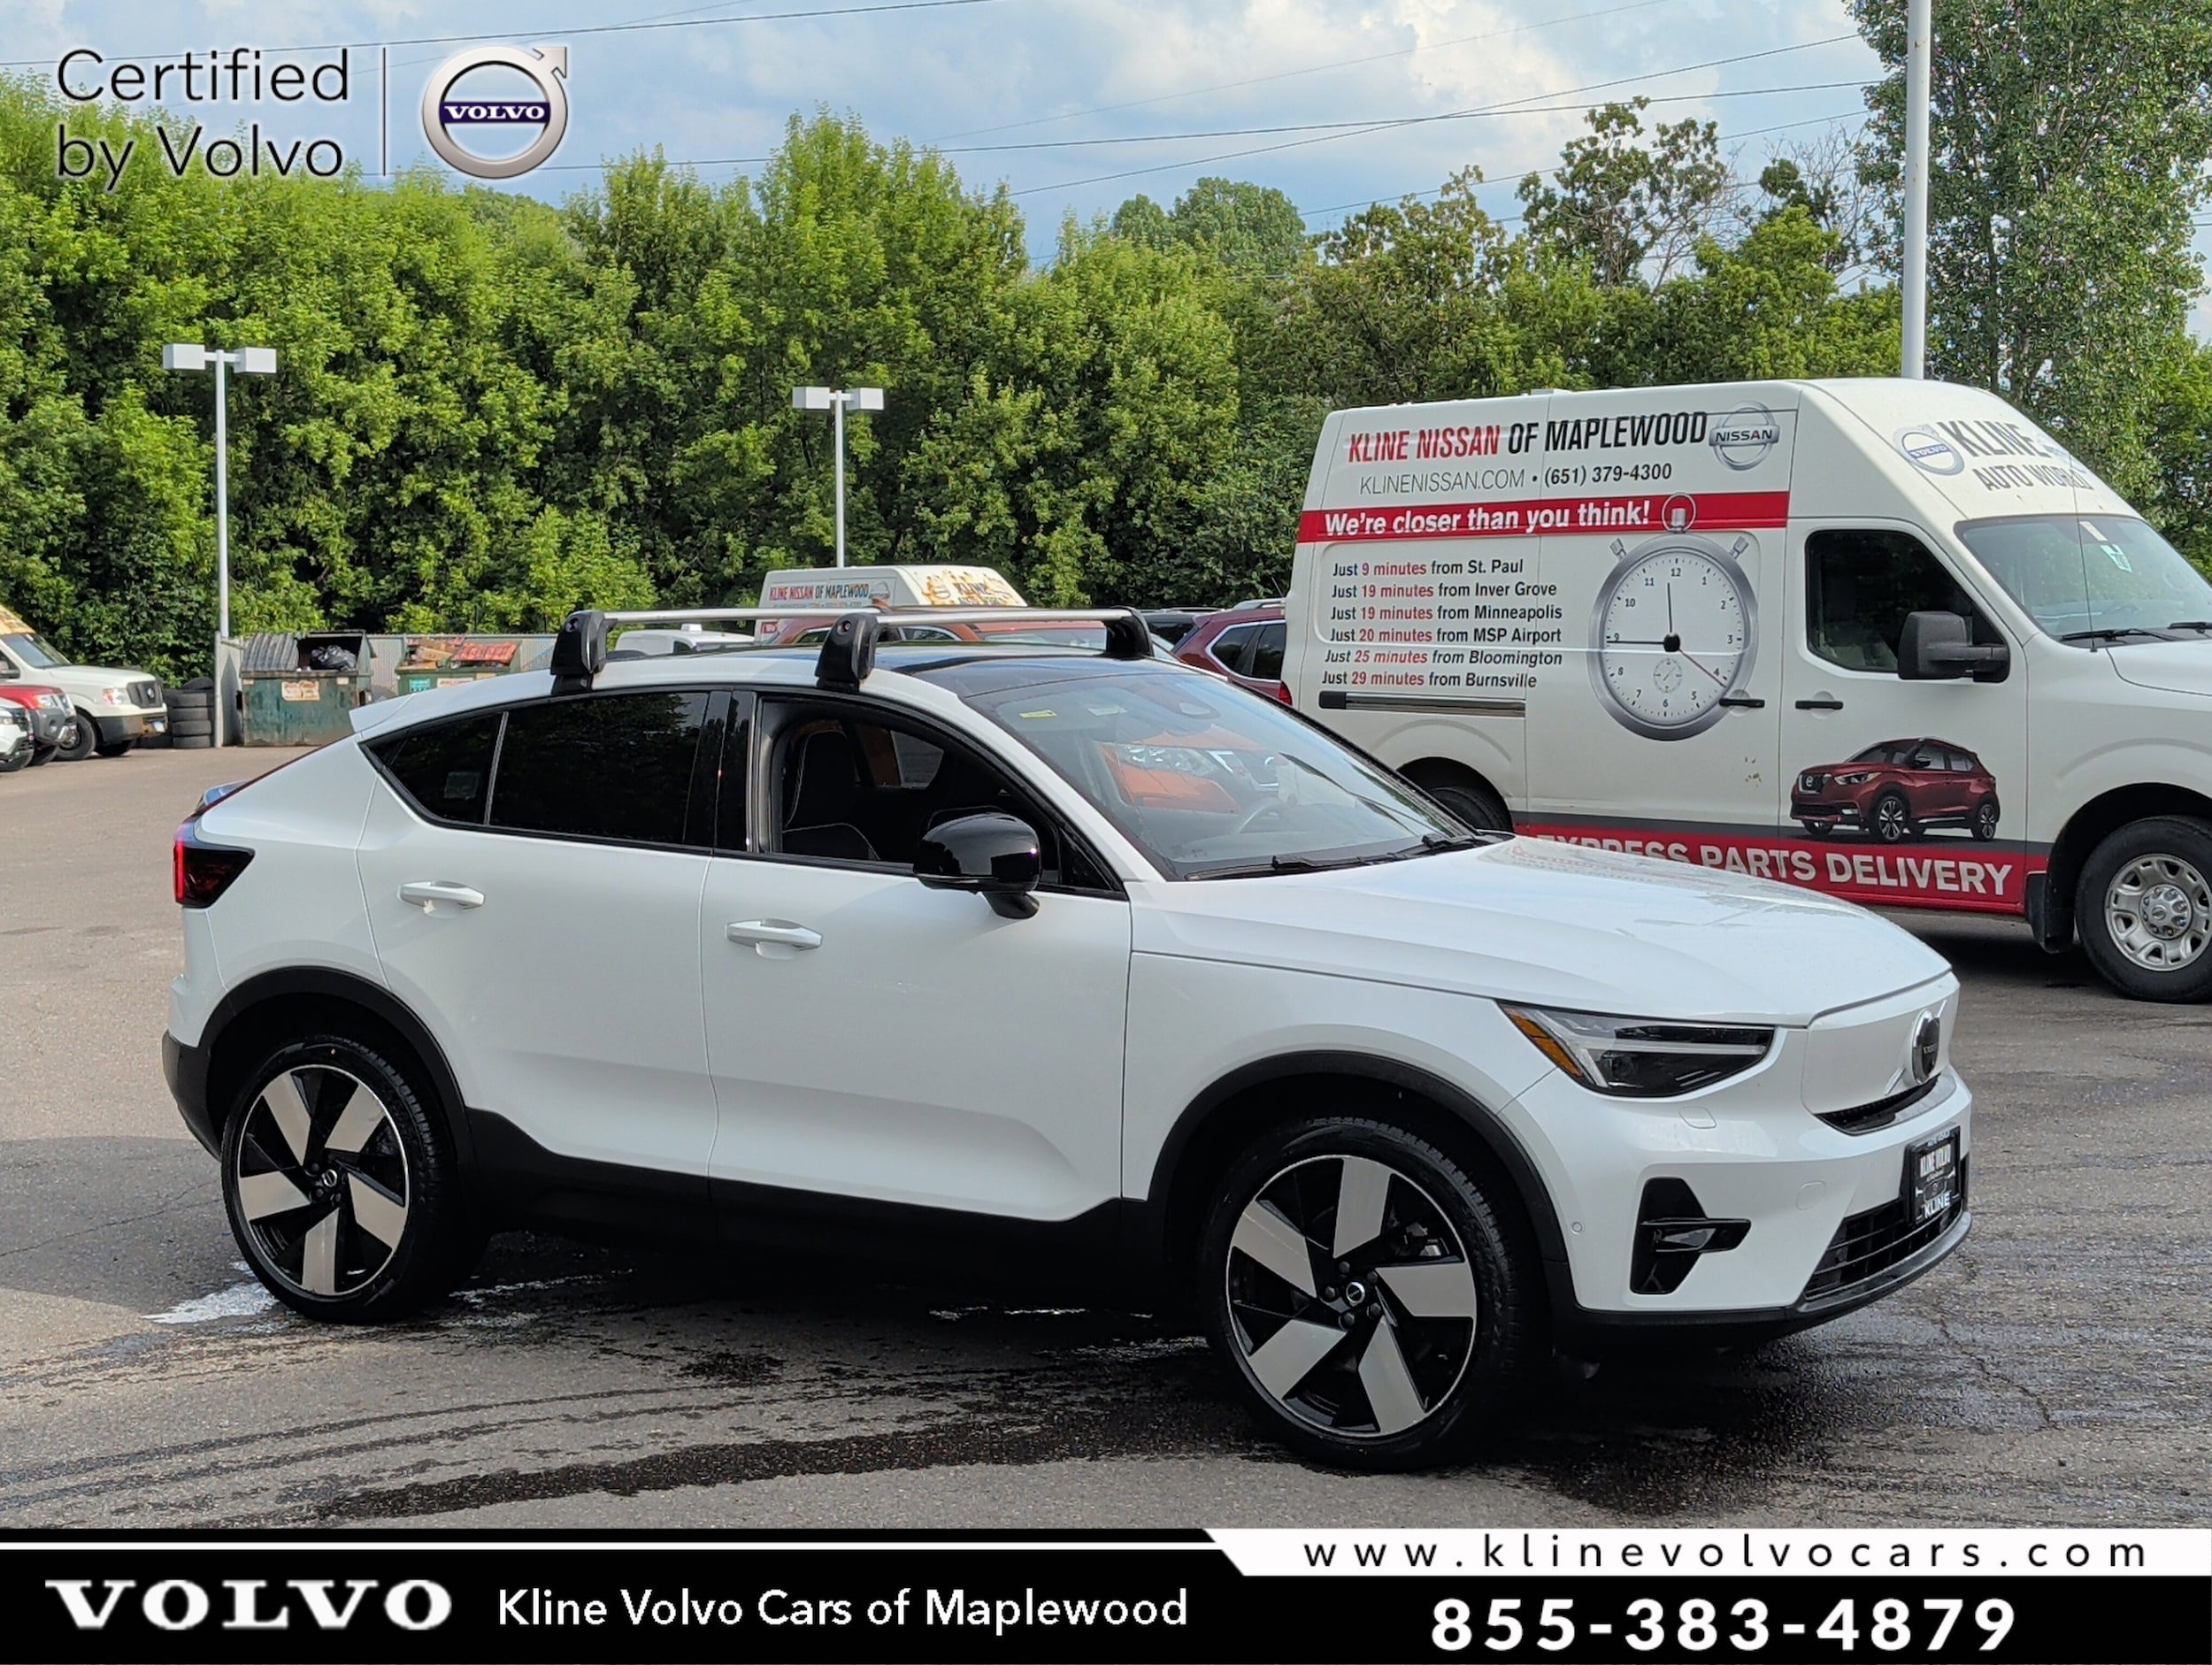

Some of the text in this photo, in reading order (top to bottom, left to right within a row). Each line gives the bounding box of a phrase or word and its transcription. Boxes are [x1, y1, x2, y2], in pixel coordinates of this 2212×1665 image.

[1348, 411, 1708, 463] KLINE NISSAN OF MAPLEWOOD
[1715, 428, 1773, 443] NISSAN
[1936, 420, 2053, 459] KLINE
[1359, 463, 1672, 495] KLINENISSAN.COM (651) 379-4300
[1972, 464, 2094, 491] AUTO WORLD
[1325, 500, 1650, 536] We're closer than you think!
[1333, 559, 1523, 576] Just 9 minutes from St. Paul
[1671, 568, 1681, 577] 12
[1332, 581, 1557, 598] Just 19 minutes from Inver Grove
[1644, 578, 1655, 587] 11
[770, 587, 787, 600] KLINE
[789, 586, 813, 600] NISSAN
[816, 585, 823, 598] OF
[826, 583, 869, 598] MAPLEWOOD
[1624, 598, 1636, 607] 10
[1720, 601, 1725, 610] 2
[1331, 604, 1563, 622] Just 19 minutes from Minneapolis
[1330, 627, 1562, 645] Just 20 minutes from MSP Airport
[1727, 635, 1732, 644] 3
[1325, 649, 1563, 668] Just 25 minutes from Bloomington
[1323, 671, 1536, 687] Just 29 minutes from Burnsville
[1636, 689, 1641, 698] 7
[1692, 691, 1697, 700] 5
[1700, 845, 1816, 881] PARTS
[1825, 852, 2012, 896] DELIVERY
